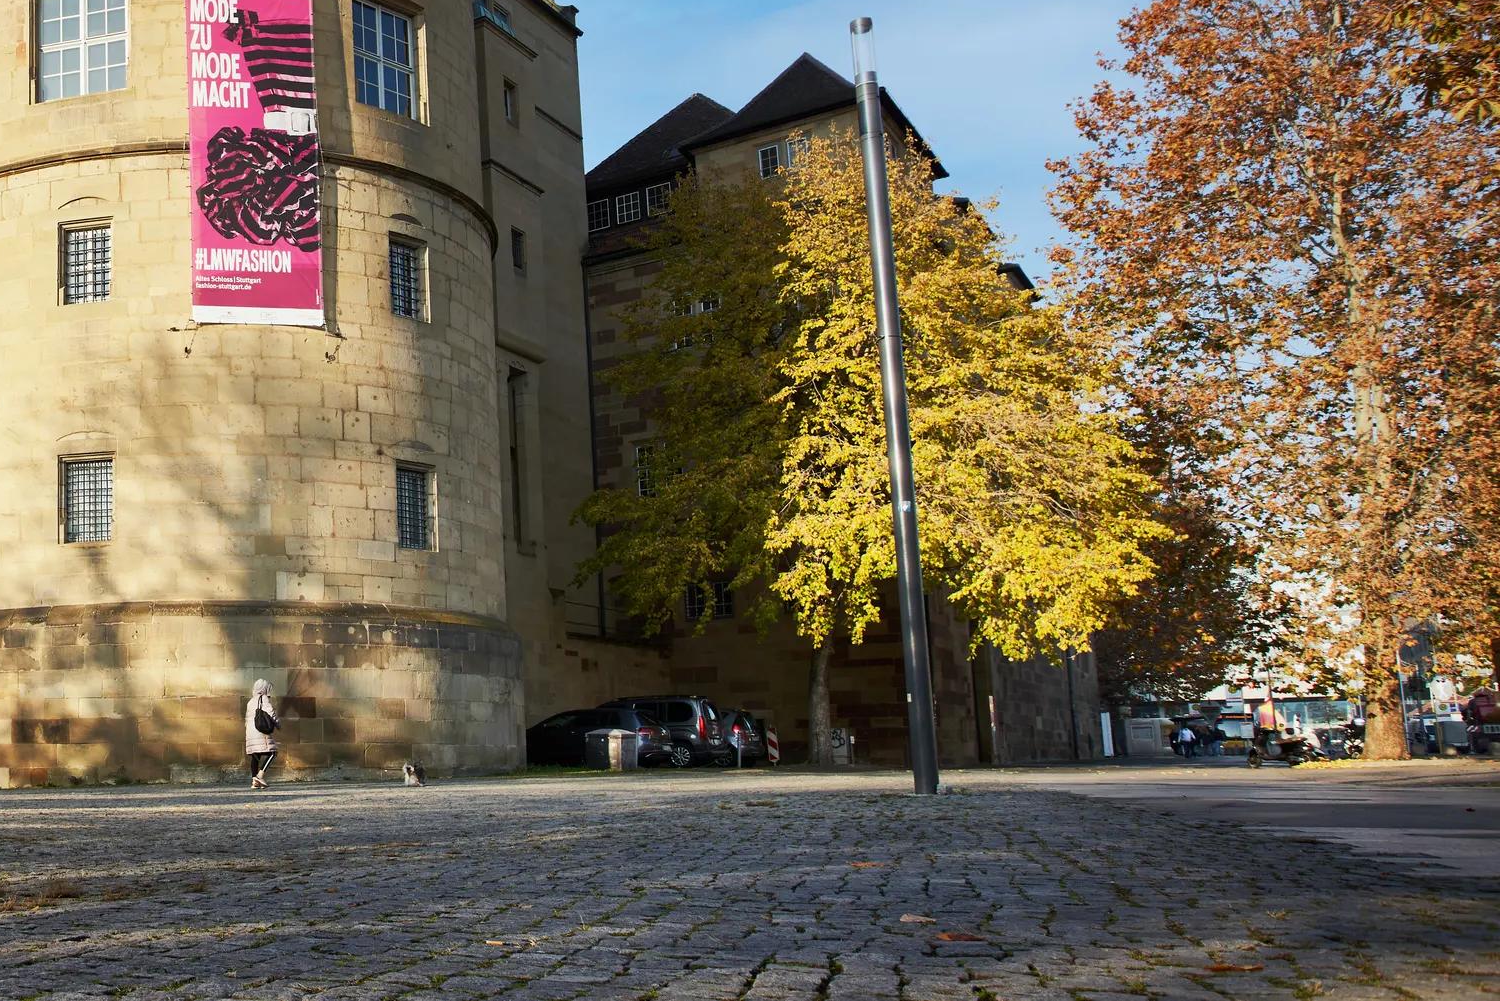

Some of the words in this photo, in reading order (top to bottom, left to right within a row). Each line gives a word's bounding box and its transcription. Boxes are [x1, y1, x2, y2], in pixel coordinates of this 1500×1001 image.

[190, 23, 212, 51] ZU
[191, 52, 242, 80] MODE
[192, 80, 251, 109] MACHT
[194, 247, 292, 273] #LMWFASHION
[195, 282, 252, 291] fashion-stuttgart.de
[210, 275, 233, 284] Schloss
[236, 276, 262, 285] Stuttgart
